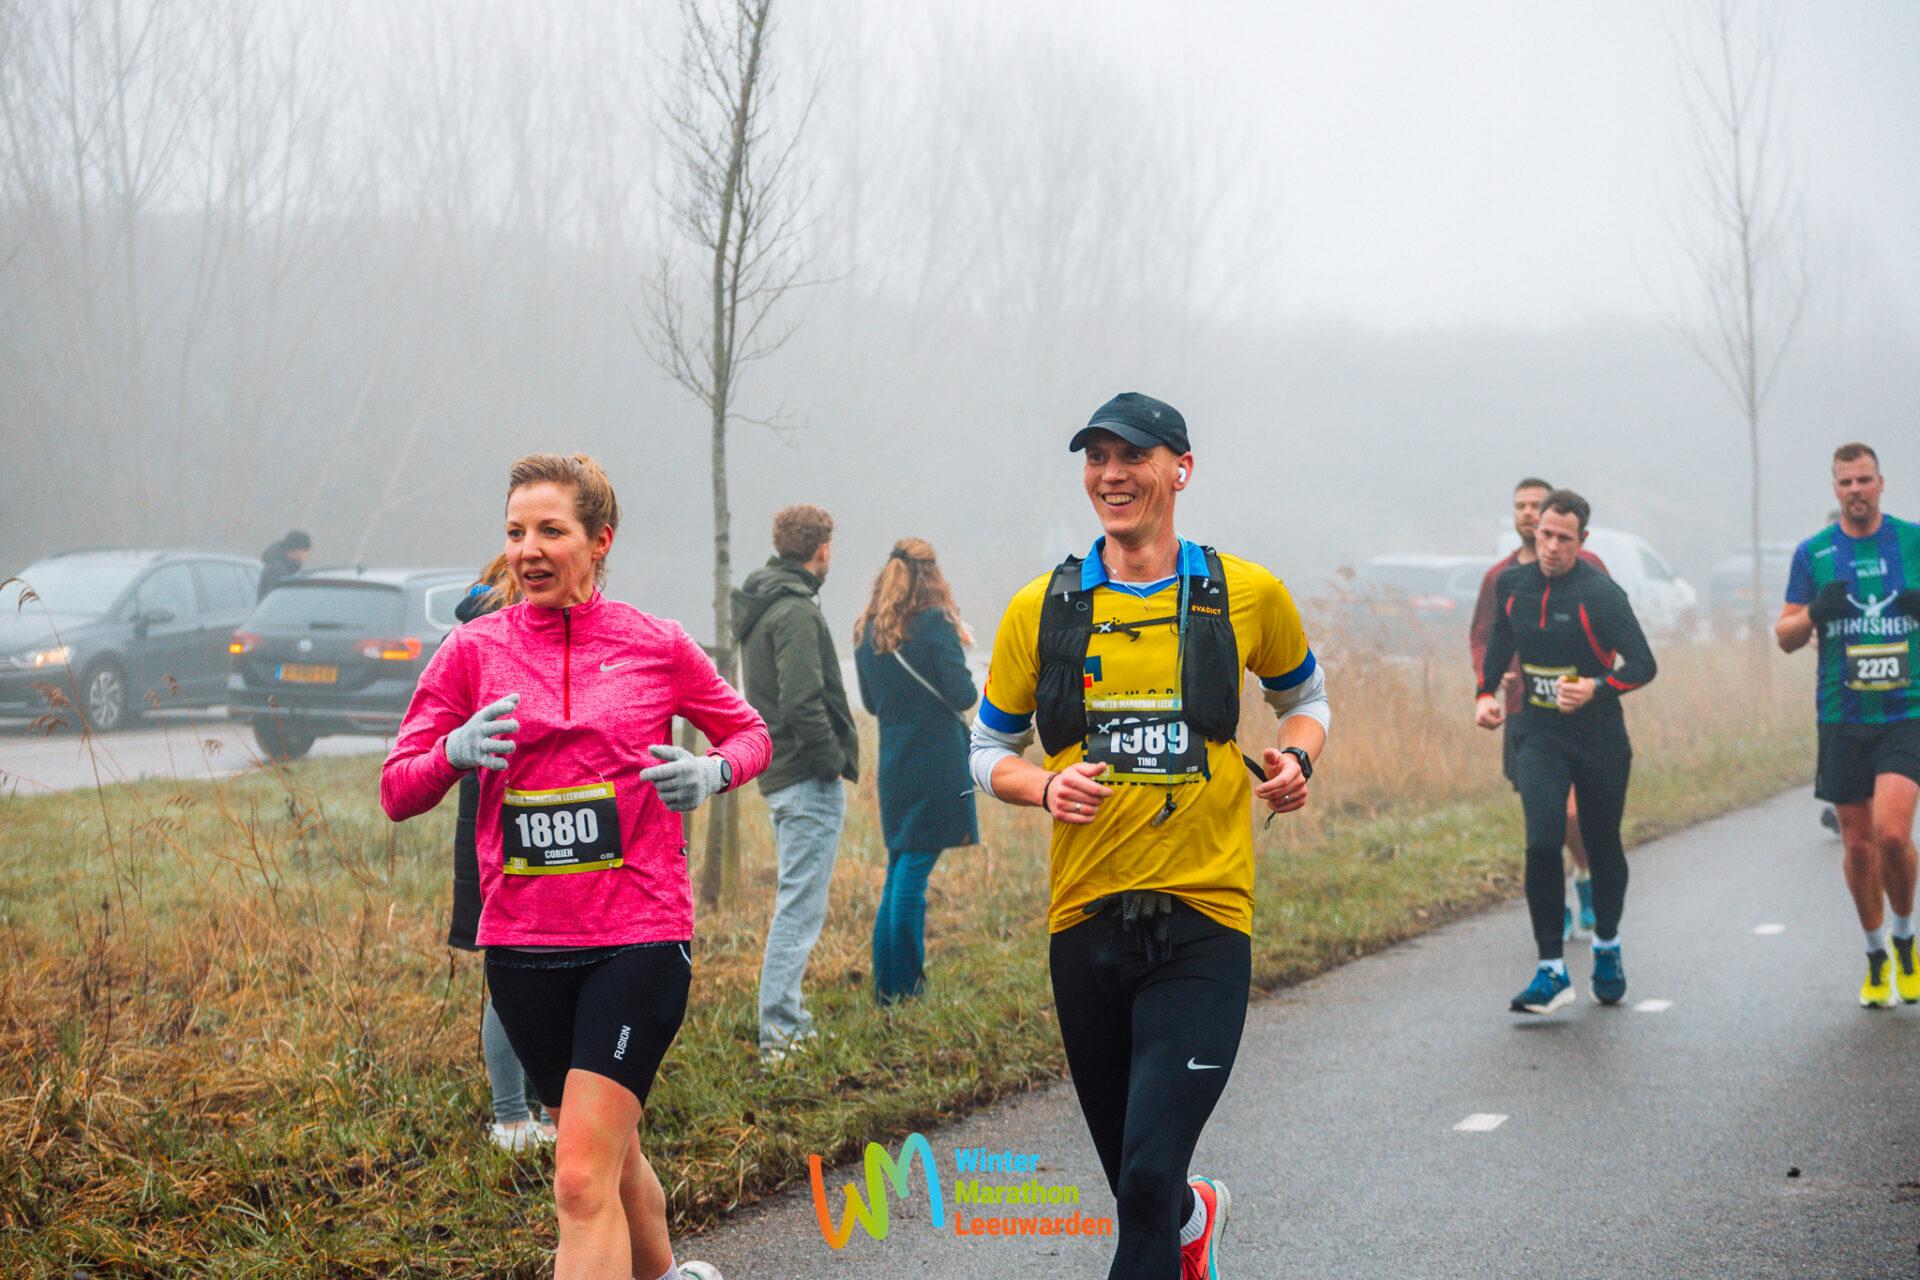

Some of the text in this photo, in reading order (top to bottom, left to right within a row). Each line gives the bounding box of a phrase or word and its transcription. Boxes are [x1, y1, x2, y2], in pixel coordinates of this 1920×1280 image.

[1191, 604, 1222, 615] EVADICT
[1857, 656, 1900, 679] 2273
[1109, 717, 1188, 754] 1989
[1137, 757, 1157, 767] TIMO
[515, 807, 599, 848] 1880
[545, 848, 573, 858] CORIEN
[613, 1025, 631, 1060] FUSION
